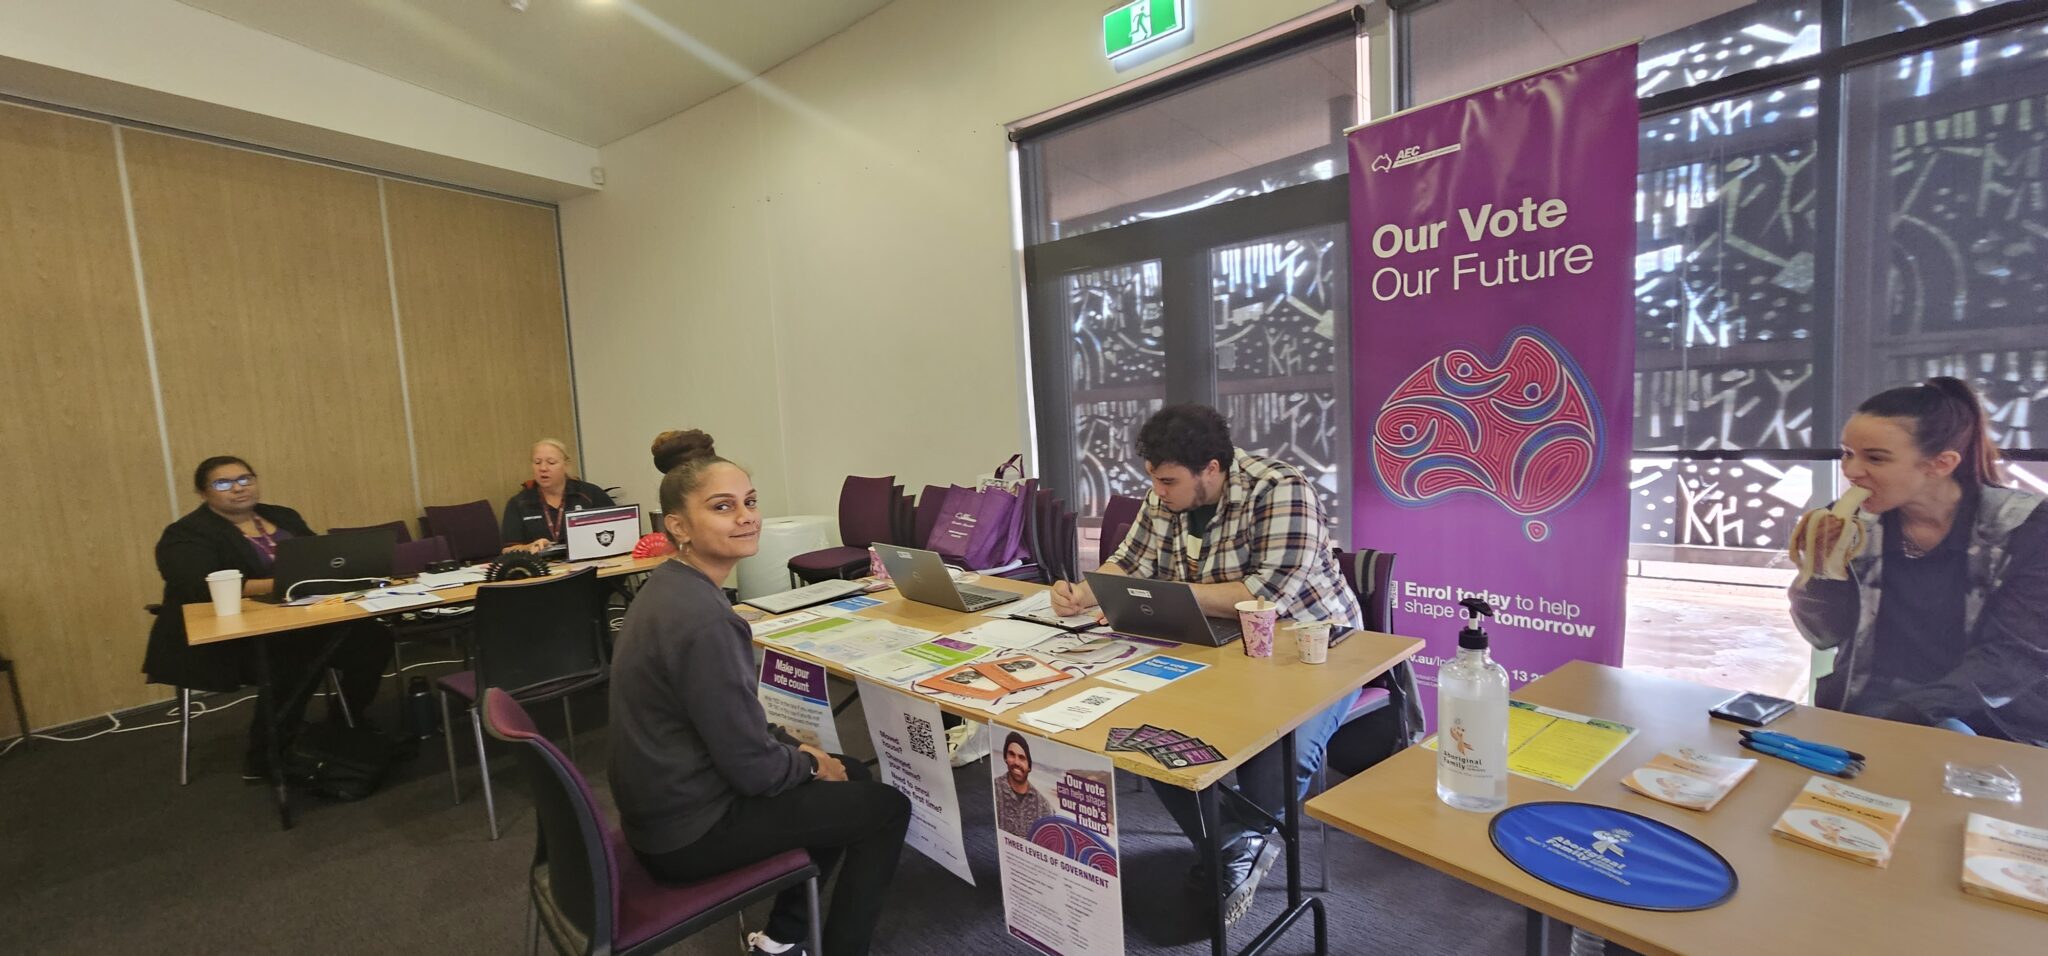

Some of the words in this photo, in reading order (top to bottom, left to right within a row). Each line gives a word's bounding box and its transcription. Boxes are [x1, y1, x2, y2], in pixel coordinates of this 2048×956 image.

[1396, 145, 1420, 161] AEC
[1372, 220, 1447, 258] Our
[1458, 197, 1568, 242] Vote
[1371, 267, 1440, 301] Our
[1453, 244, 1594, 290] Future
[1405, 581, 1452, 601] Enrol
[1456, 587, 1511, 610] today
[1515, 594, 1534, 611] to
[1539, 596, 1580, 620] help
[1405, 599, 1454, 619] shape
[1493, 609, 1596, 638] tomorrow
[774, 673, 788, 686] vote
[775, 658, 794, 675] Make
[793, 667, 810, 680] your
[1511, 669, 1528, 682] 13
[1530, 672, 1544, 682] 2
[1066, 774, 1083, 790] Our
[1084, 782, 1105, 797] vote
[1061, 798, 1076, 810] our
[1079, 803, 1107, 821] mob's
[1086, 794, 1106, 808] shape
[1078, 813, 1108, 834] future
[1004, 837, 1024, 852] THREE
[1025, 846, 1048, 863] LEVELS
[1049, 857, 1059, 867] OF
[1060, 861, 1109, 889] GOVERNMENT
